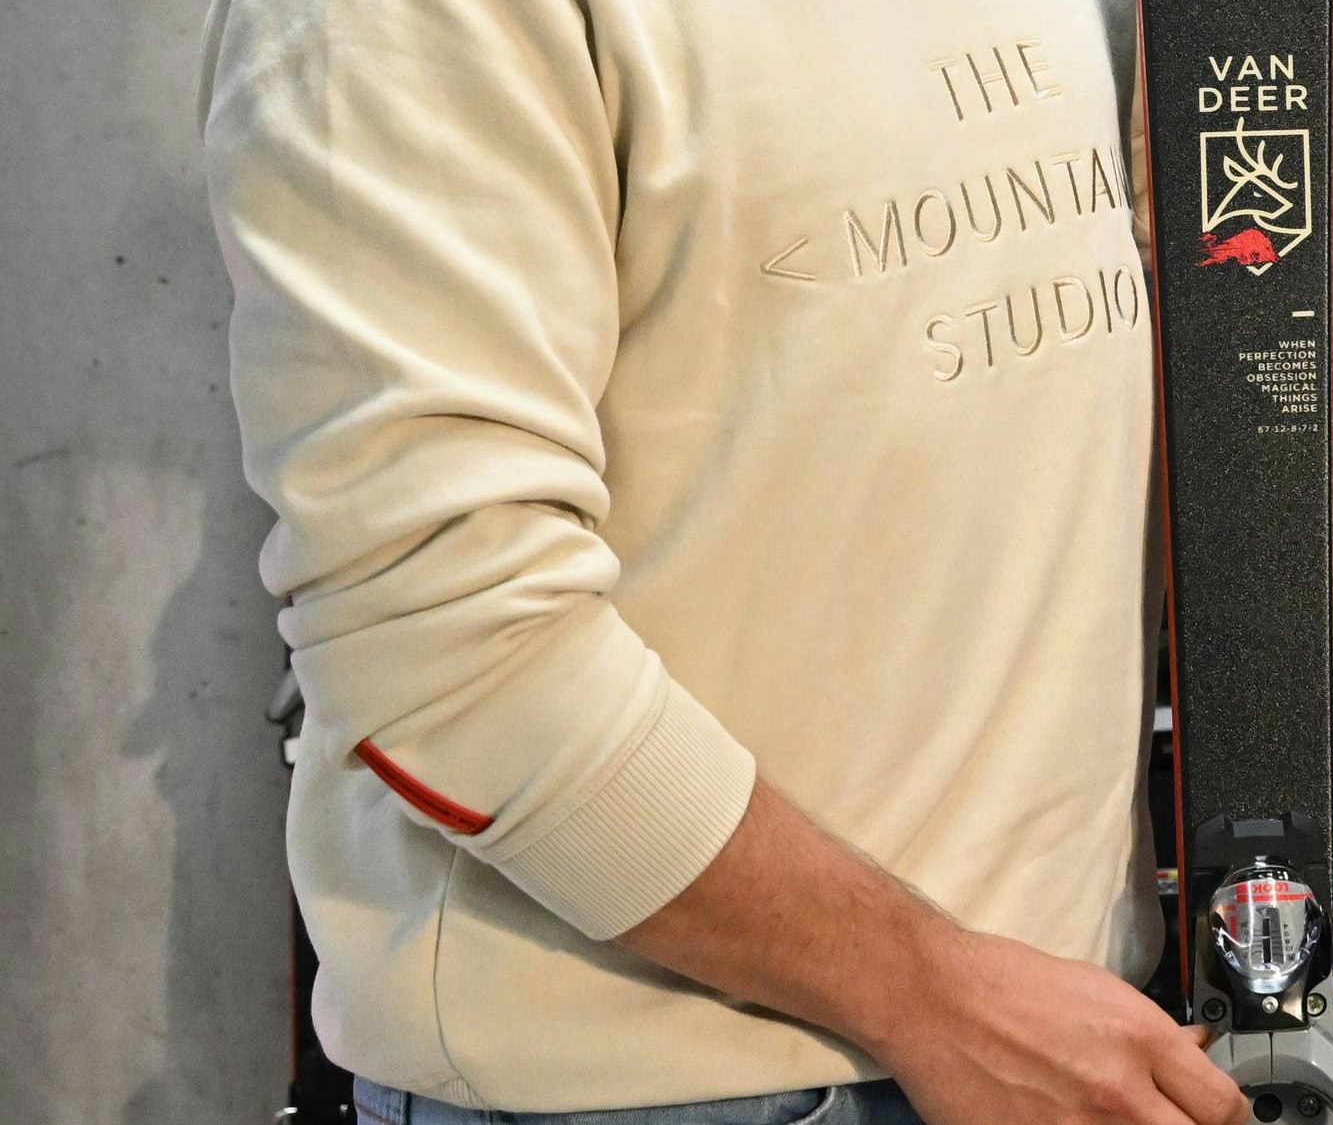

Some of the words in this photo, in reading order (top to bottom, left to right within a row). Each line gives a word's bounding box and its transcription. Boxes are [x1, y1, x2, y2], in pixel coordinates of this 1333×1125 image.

[1208, 54, 1295, 81] VAN
[925, 38, 1063, 122] THE
[1199, 85, 1309, 113] DEER
[924, 263, 1140, 382] STUDIO
[1278, 340, 1316, 349] WHEN
[1238, 350, 1316, 361] PERFECTION
[1258, 361, 1317, 371] BECOMES
[1246, 372, 1317, 382] OBSESSION
[1261, 383, 1317, 393] MAGICAL
[1272, 393, 1318, 403] THINGS
[1281, 404, 1318, 413] ARISE
